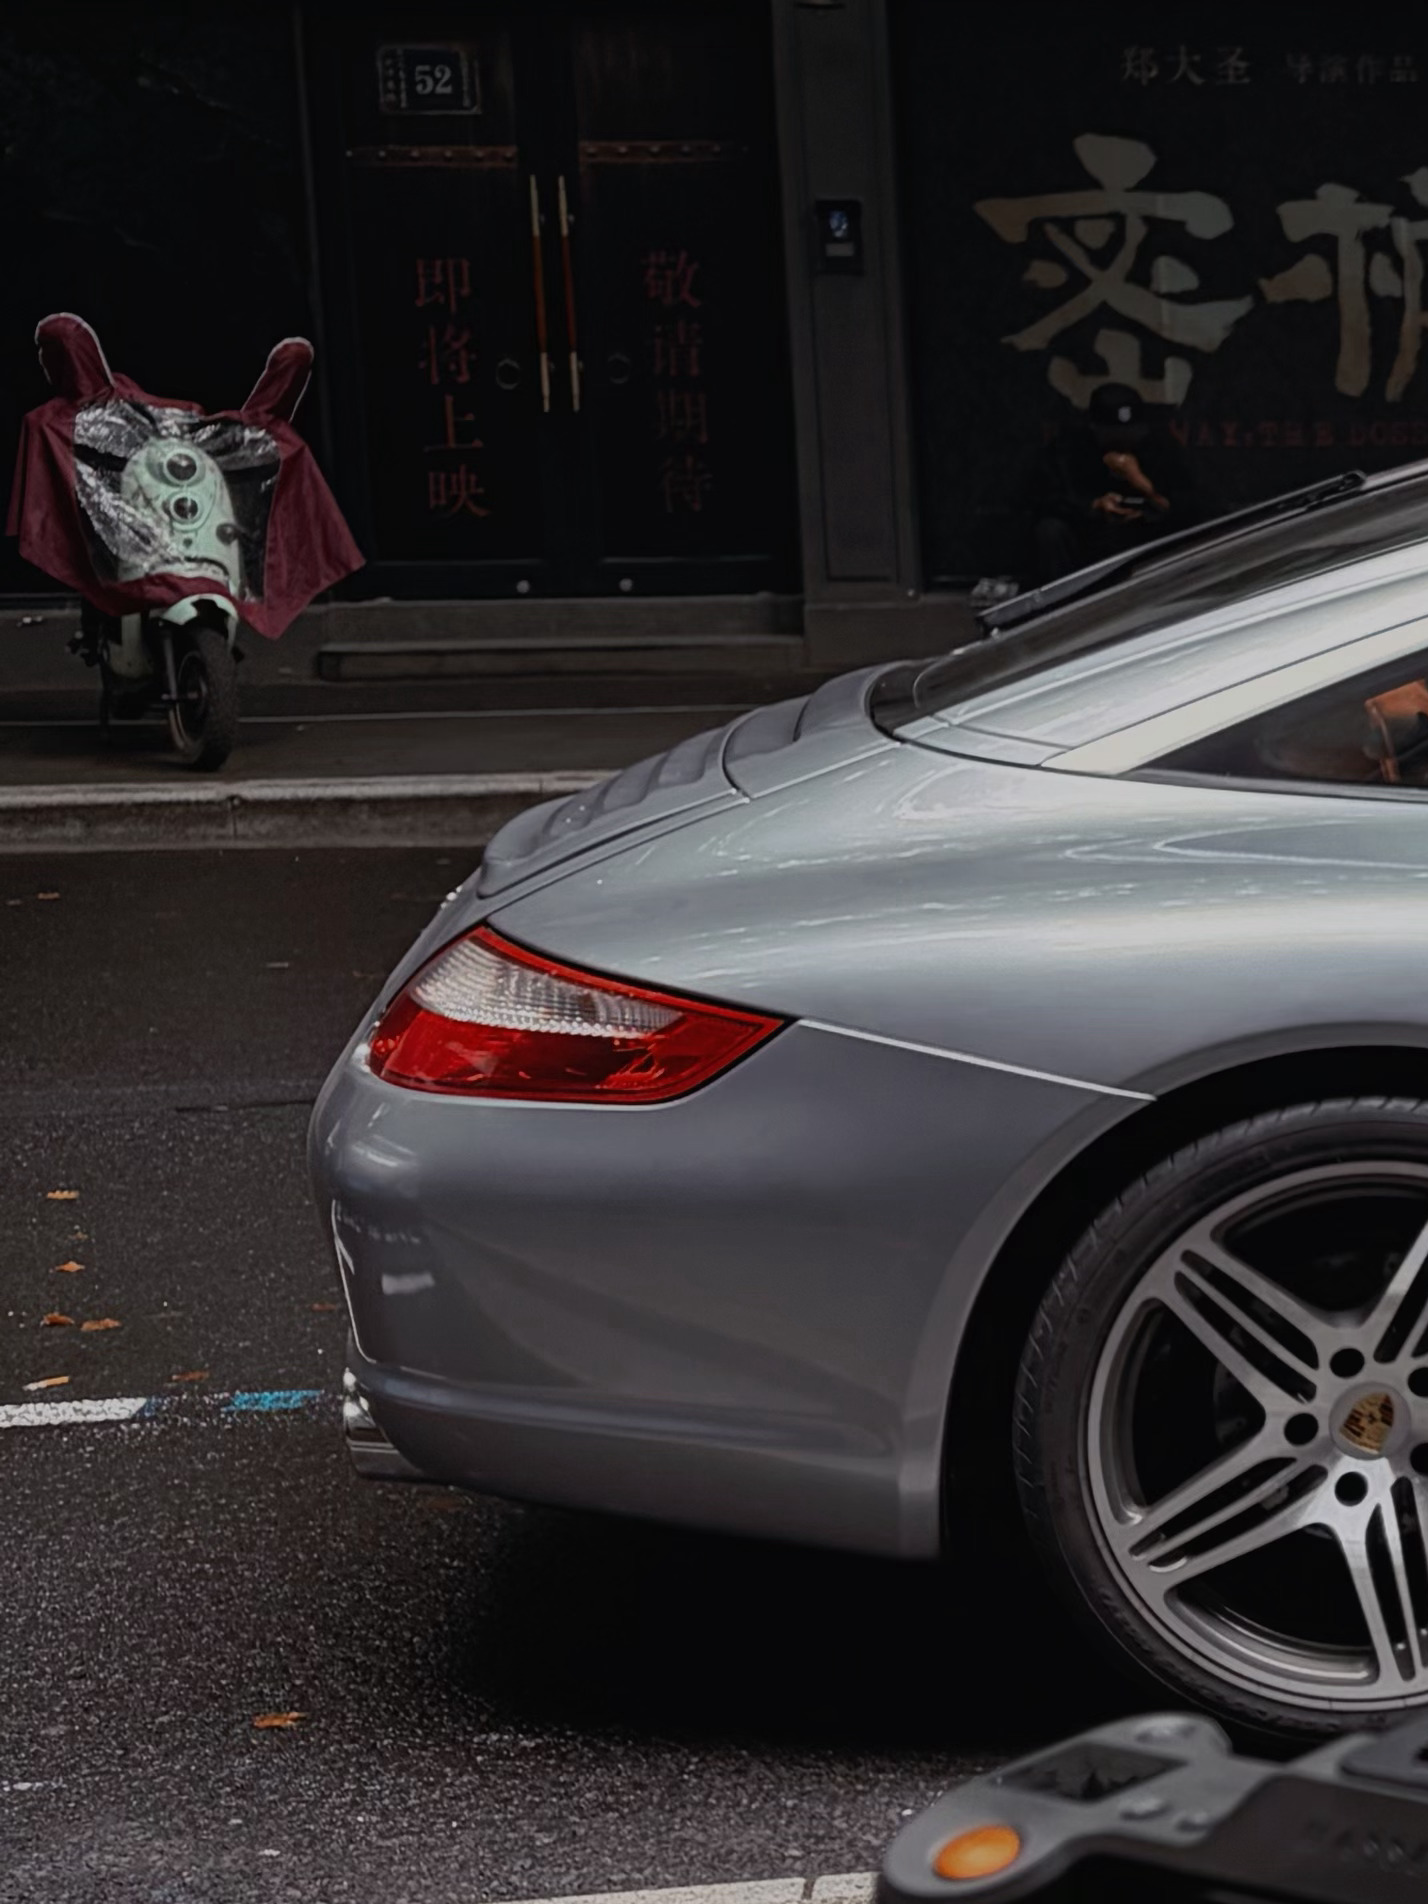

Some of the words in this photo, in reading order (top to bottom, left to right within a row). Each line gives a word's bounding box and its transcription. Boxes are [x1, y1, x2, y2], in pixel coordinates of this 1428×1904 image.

[414, 63, 454, 95] 52
[1121, 44, 1252, 86] 郑大圣
[1286, 52, 1420, 84] 导演作品
[414, 256, 492, 519] 即将上映
[641, 248, 715, 514] 敬请期待
